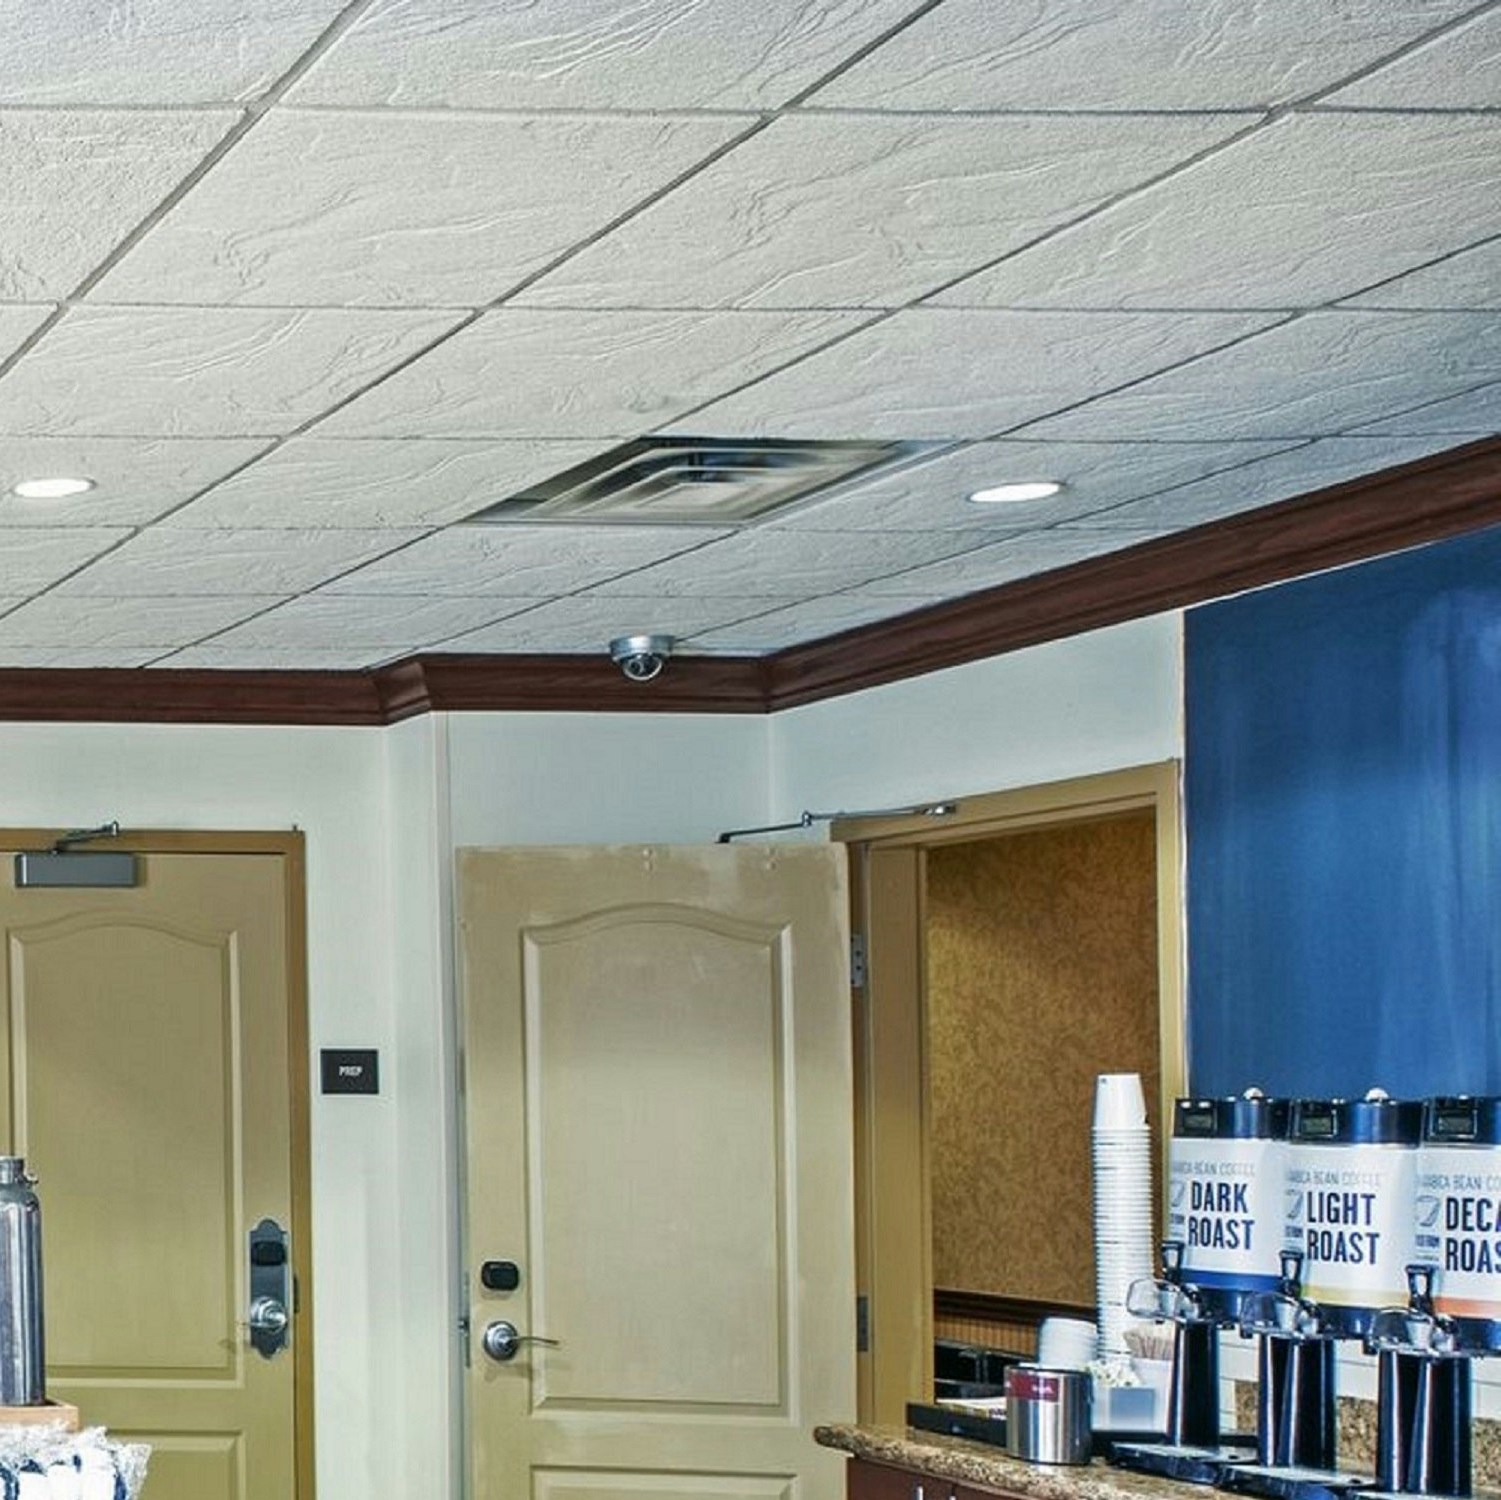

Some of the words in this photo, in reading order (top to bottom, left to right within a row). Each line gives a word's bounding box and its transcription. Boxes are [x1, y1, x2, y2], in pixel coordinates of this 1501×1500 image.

[1191, 1180, 1248, 1213] DARK
[1306, 1191, 1376, 1226] LIGHT
[1188, 1216, 1255, 1250] ROAST
[1306, 1229, 1380, 1265] ROAST
